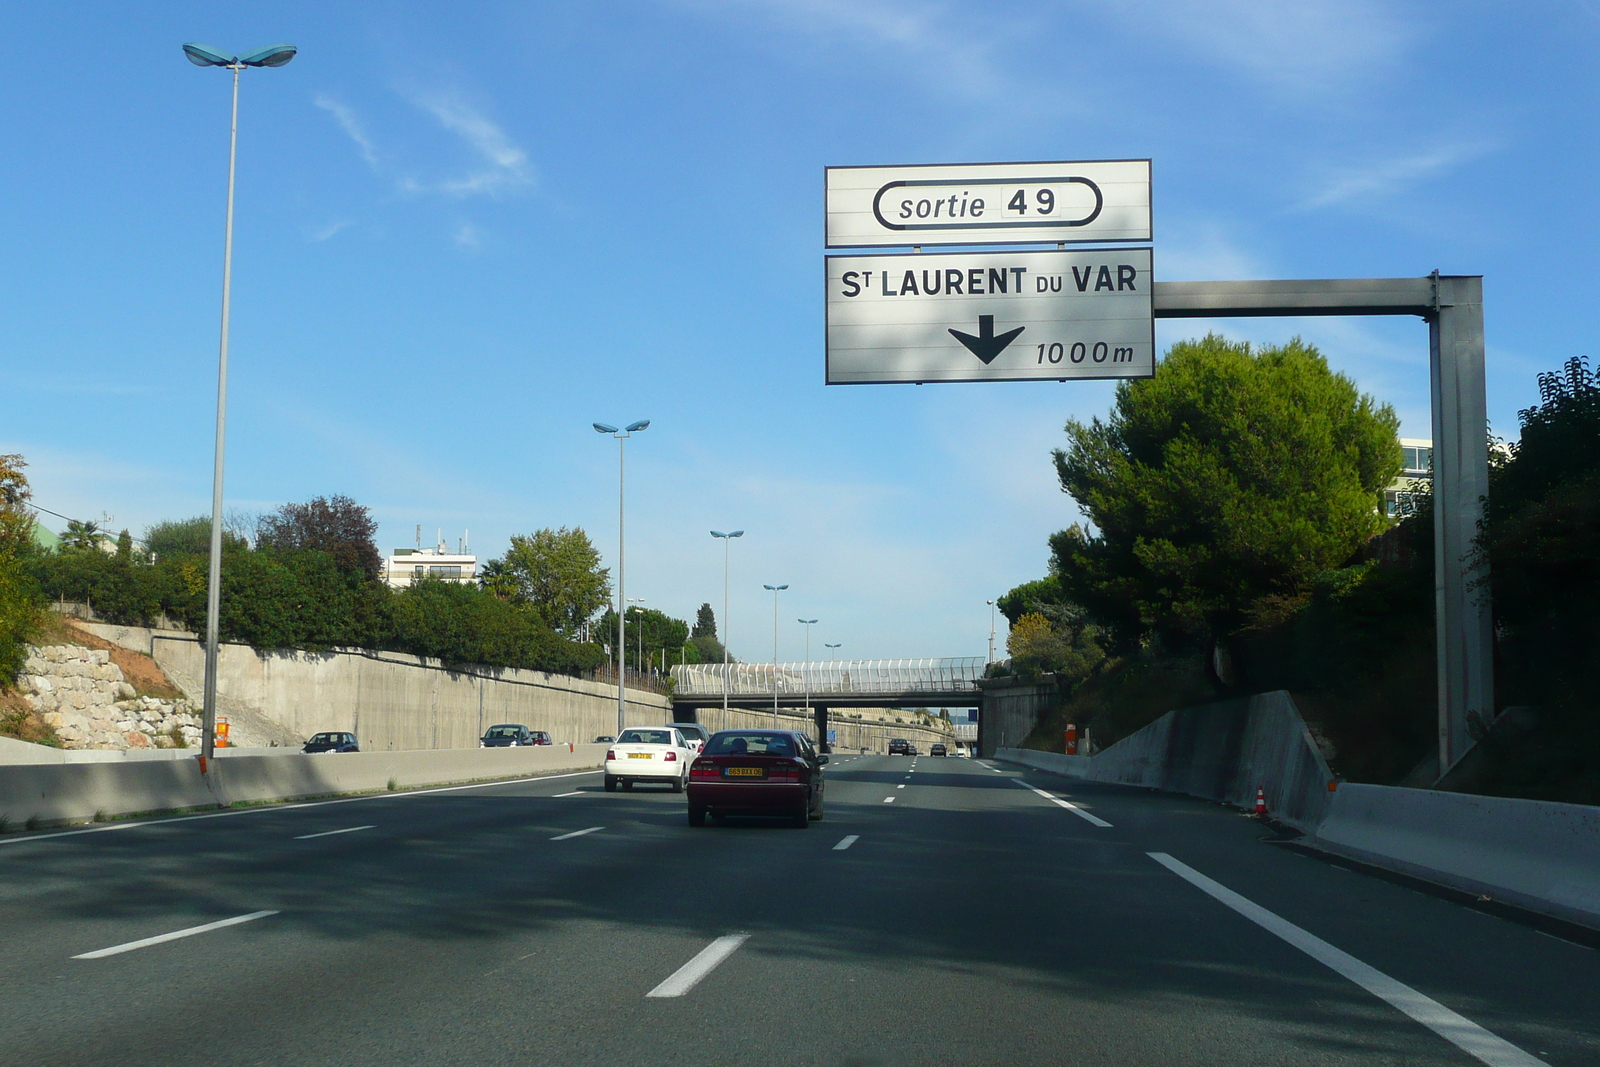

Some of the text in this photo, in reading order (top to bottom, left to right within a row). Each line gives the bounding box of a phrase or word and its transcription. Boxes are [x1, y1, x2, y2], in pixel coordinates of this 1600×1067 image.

[899, 188, 1055, 219] sortie 49
[882, 267, 1027, 296] LAURENT
[1036, 276, 1062, 293] DU
[1072, 265, 1137, 292] VAR
